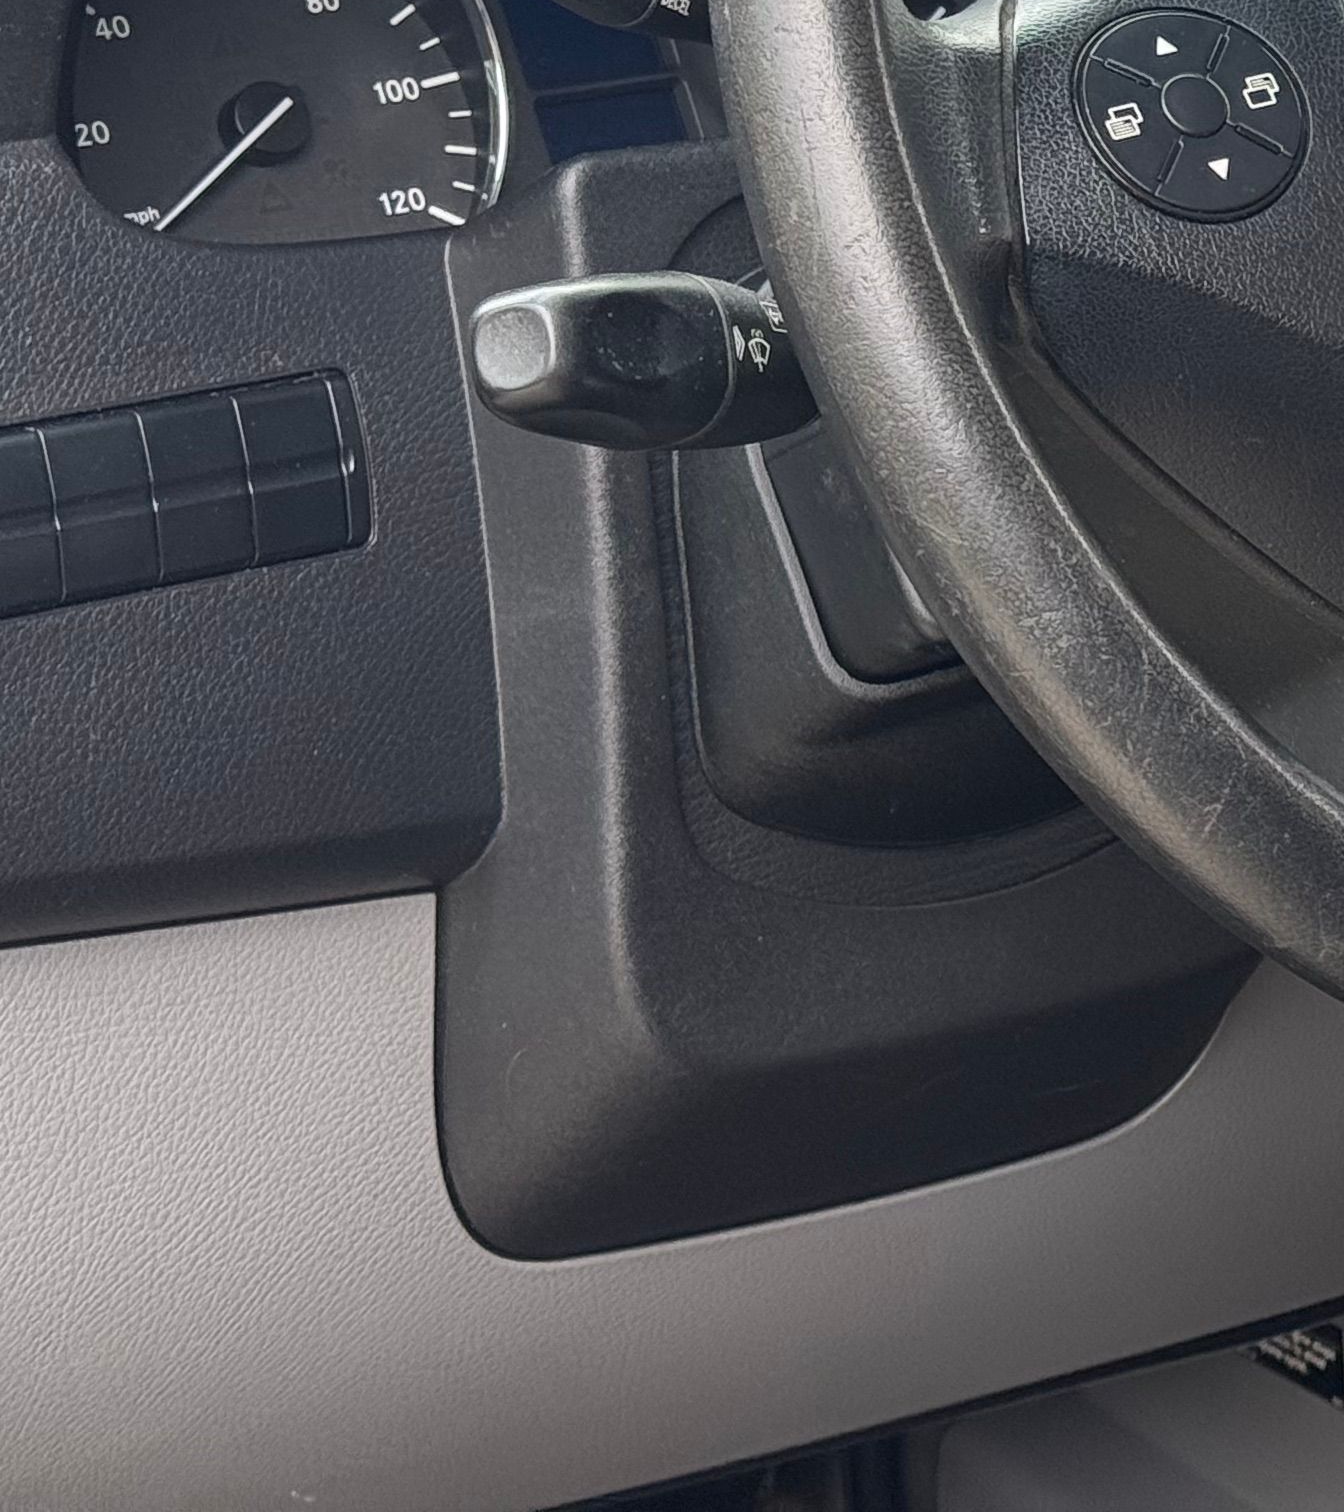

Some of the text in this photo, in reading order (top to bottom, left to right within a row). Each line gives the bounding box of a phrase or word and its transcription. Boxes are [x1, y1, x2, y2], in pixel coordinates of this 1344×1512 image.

[95, 15, 131, 41] 40
[372, 76, 420, 105] 100
[74, 120, 111, 147] 20
[378, 187, 426, 216] 120
